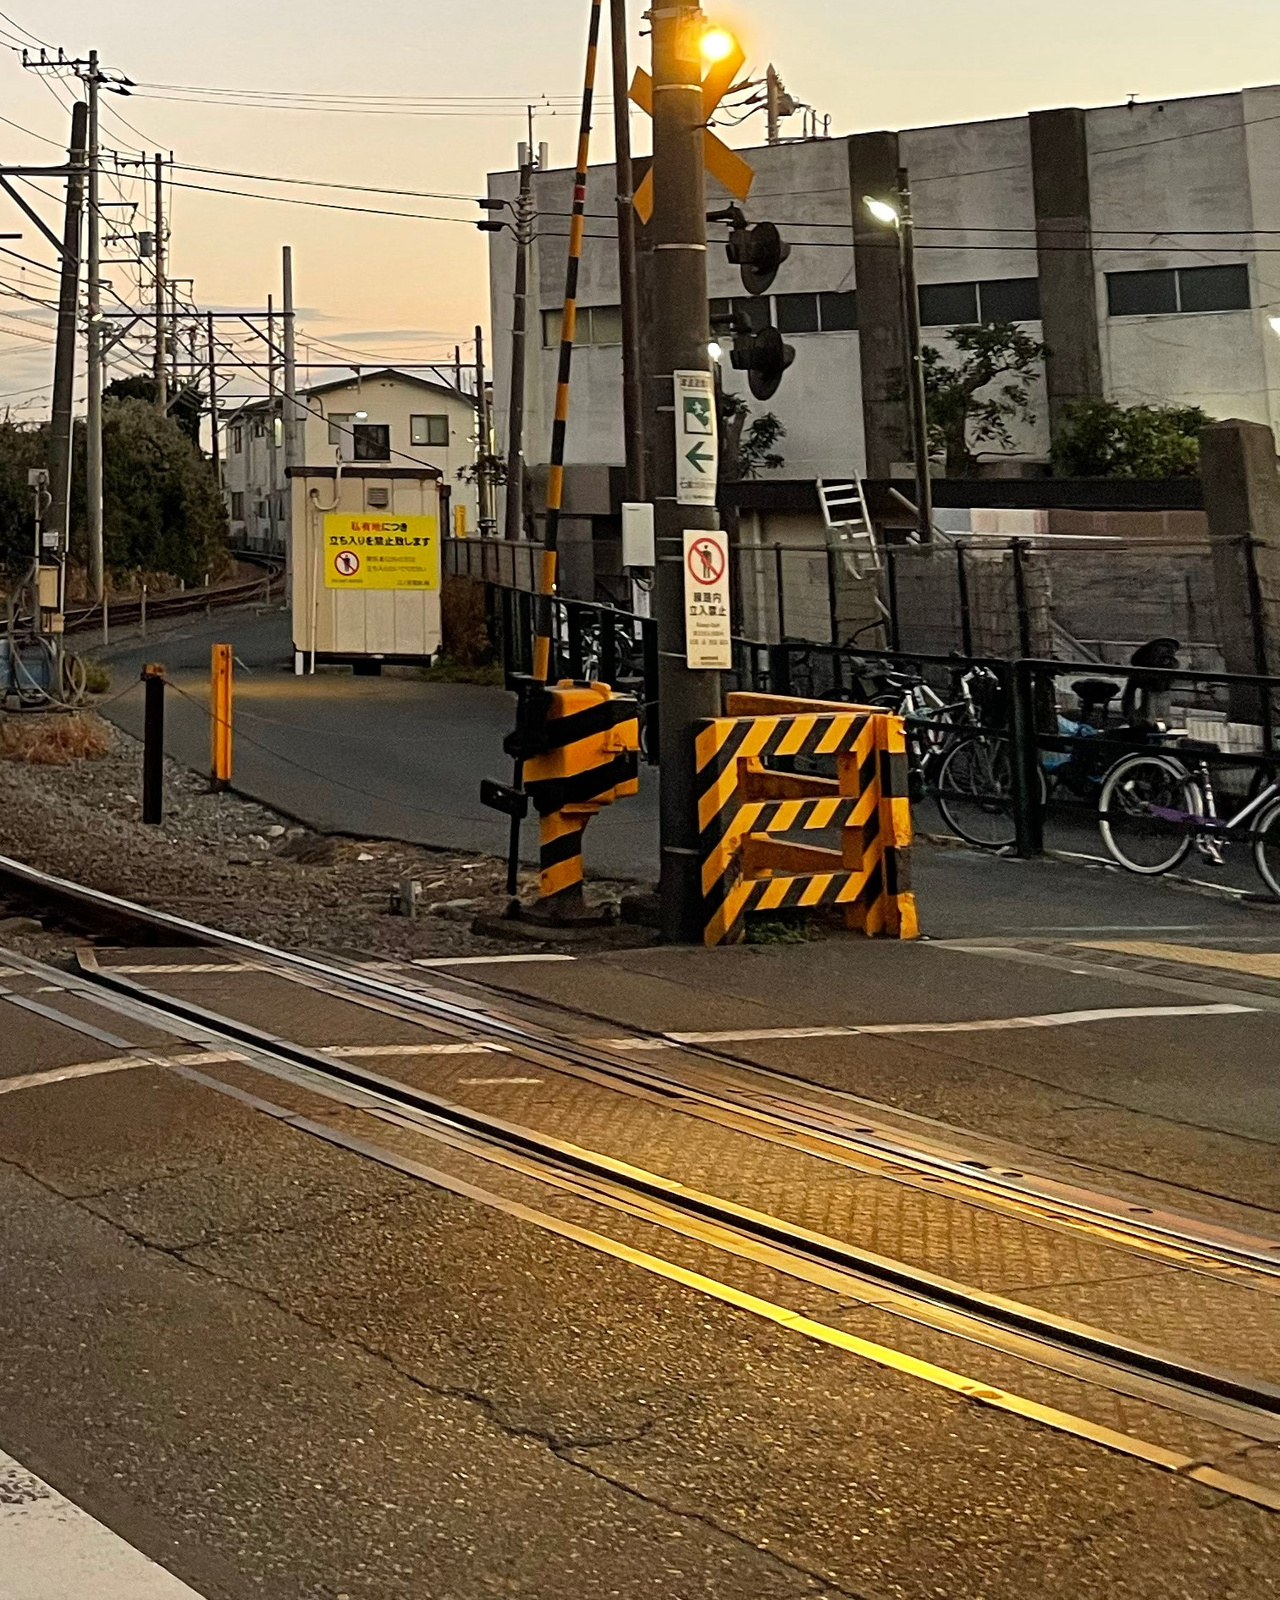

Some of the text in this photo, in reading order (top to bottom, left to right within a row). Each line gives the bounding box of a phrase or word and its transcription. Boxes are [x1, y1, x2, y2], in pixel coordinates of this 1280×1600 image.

[351, 521, 408, 532] 私有地につき
[689, 605, 727, 617] 立入禁止
